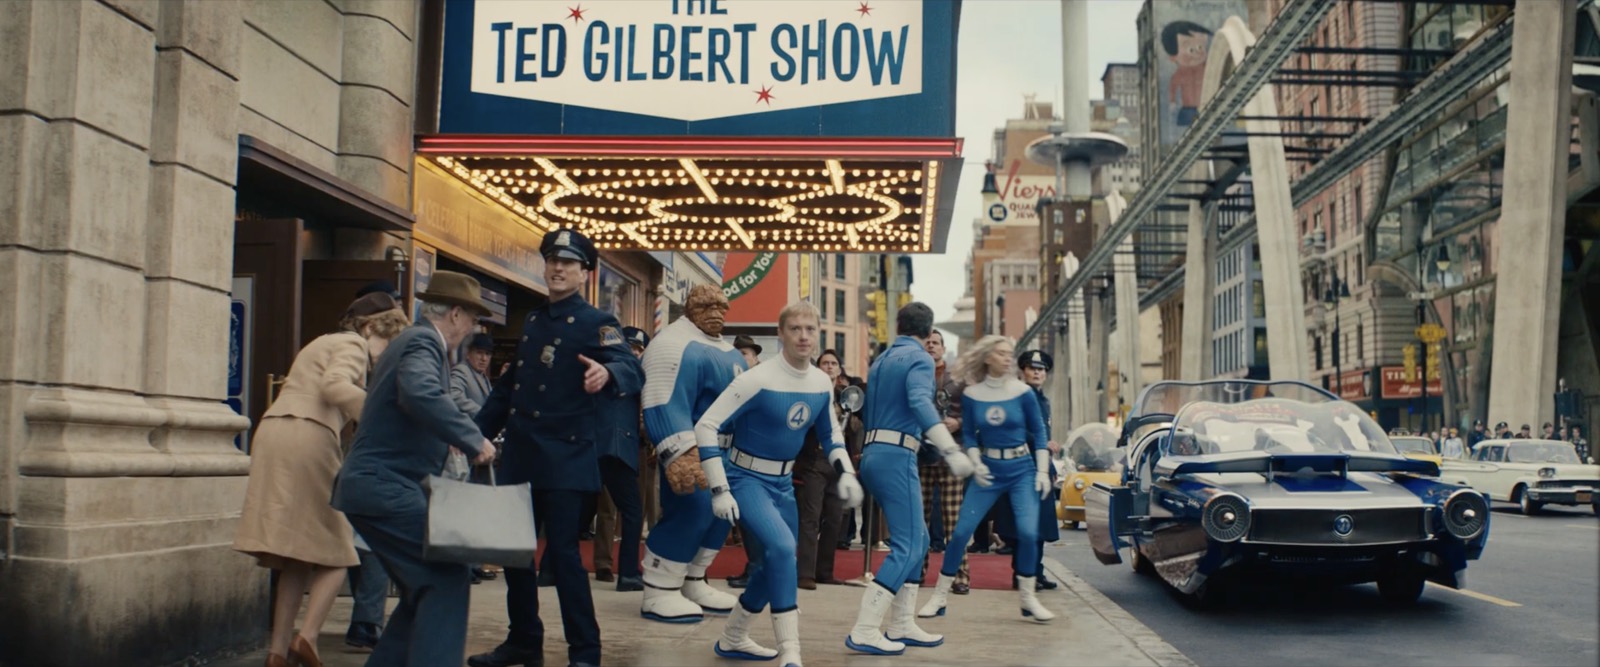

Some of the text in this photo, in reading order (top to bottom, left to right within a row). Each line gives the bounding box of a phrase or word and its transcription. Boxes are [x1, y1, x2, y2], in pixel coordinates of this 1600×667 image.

[491, 18, 909, 87] TED GILBERT SHOW
[739, 270, 758, 289] for
[790, 405, 805, 426] 4
